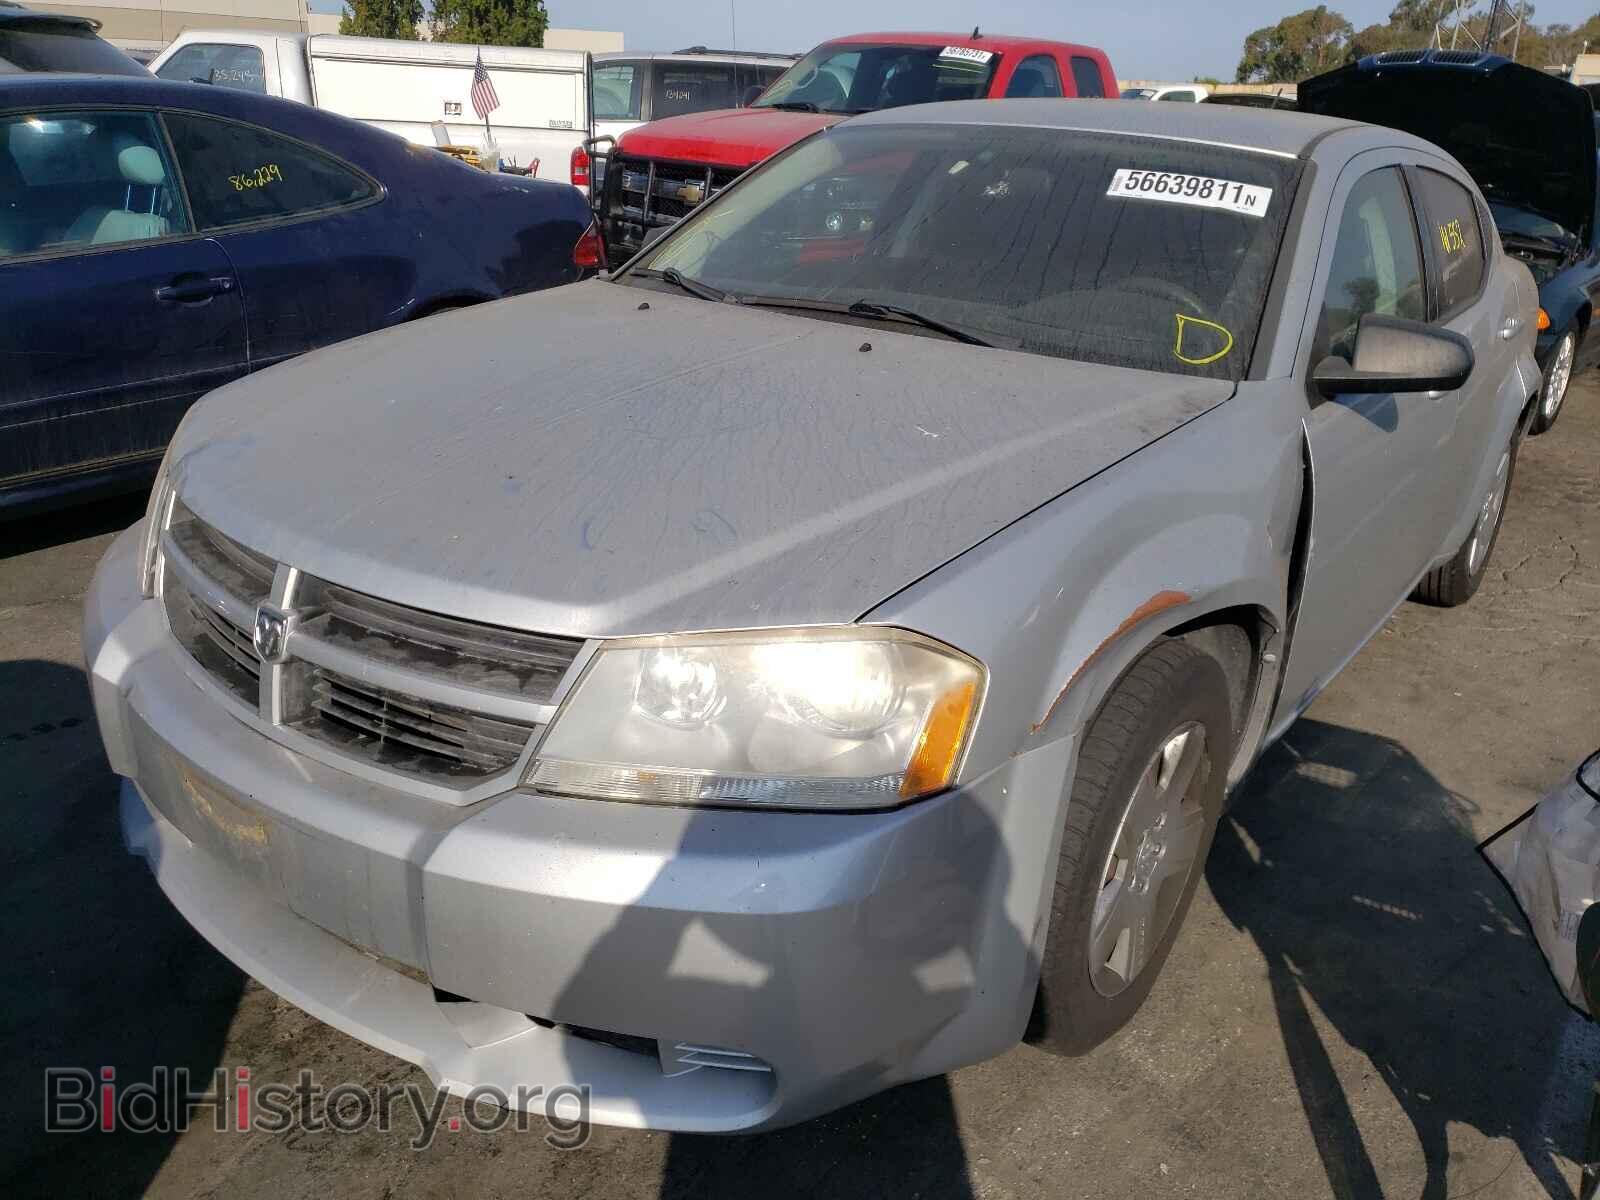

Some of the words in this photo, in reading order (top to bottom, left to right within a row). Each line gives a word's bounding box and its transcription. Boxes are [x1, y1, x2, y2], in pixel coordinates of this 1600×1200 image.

[1124, 171, 1244, 204] 56639811
[1244, 194, 1257, 207] N
[1174, 313, 1234, 366] D
